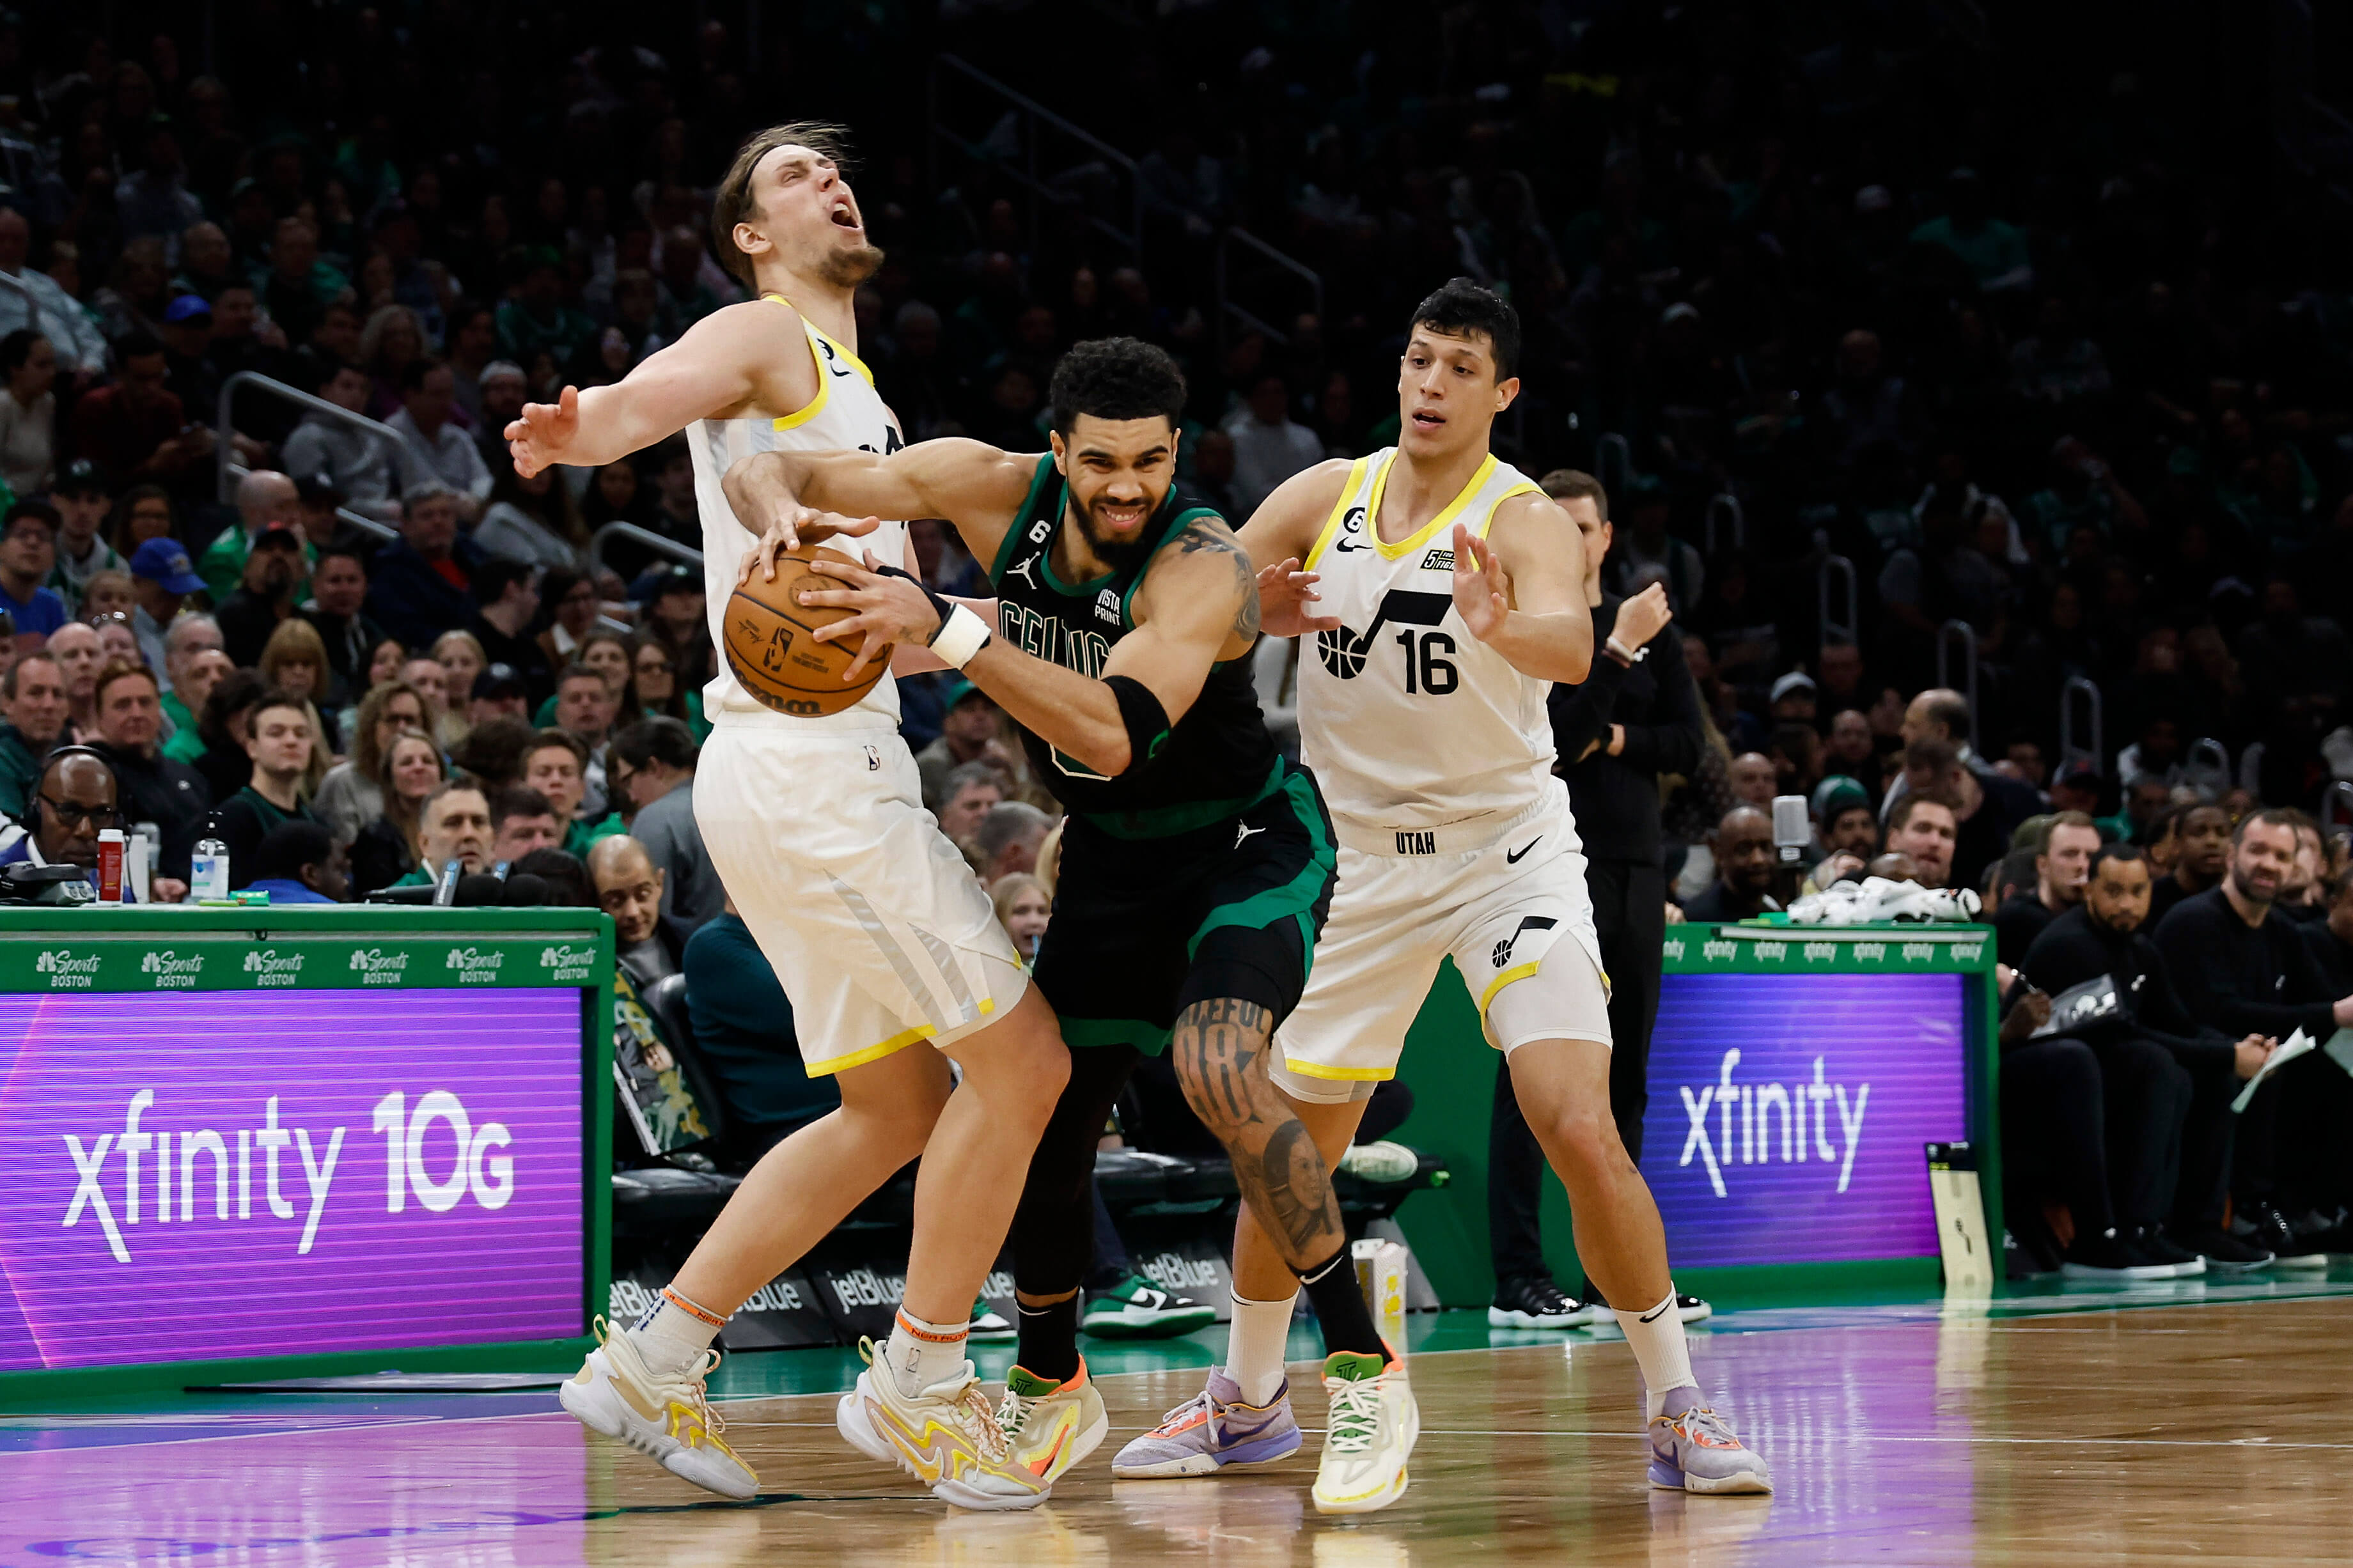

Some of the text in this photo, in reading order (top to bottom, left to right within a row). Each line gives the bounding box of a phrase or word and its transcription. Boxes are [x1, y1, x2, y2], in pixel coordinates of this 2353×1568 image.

[1029, 520, 1051, 544] 6
[1424, 550, 1439, 568] 5
[1097, 588, 1120, 613] VISTA
[1095, 604, 1120, 626] PRINT
[1396, 629, 1458, 695] 16
[1396, 832, 1436, 855] UTAH
[55, 950, 101, 974] Sports
[160, 950, 205, 974] Sports
[262, 949, 304, 974] Sports
[366, 948, 409, 972] Sports
[464, 947, 504, 970] Sports
[556, 945, 597, 968] Sports
[51, 975, 92, 988] BOSTON
[155, 975, 196, 987] BOSTON
[256, 974, 296, 986] BOSTON
[363, 972, 401, 984] BOSTON
[459, 970, 497, 982] BOSTON
[553, 968, 589, 981] BOSTON
[1679, 1047, 1870, 1198] xfinity
[62, 1089, 513, 1264] xfinity 10G
